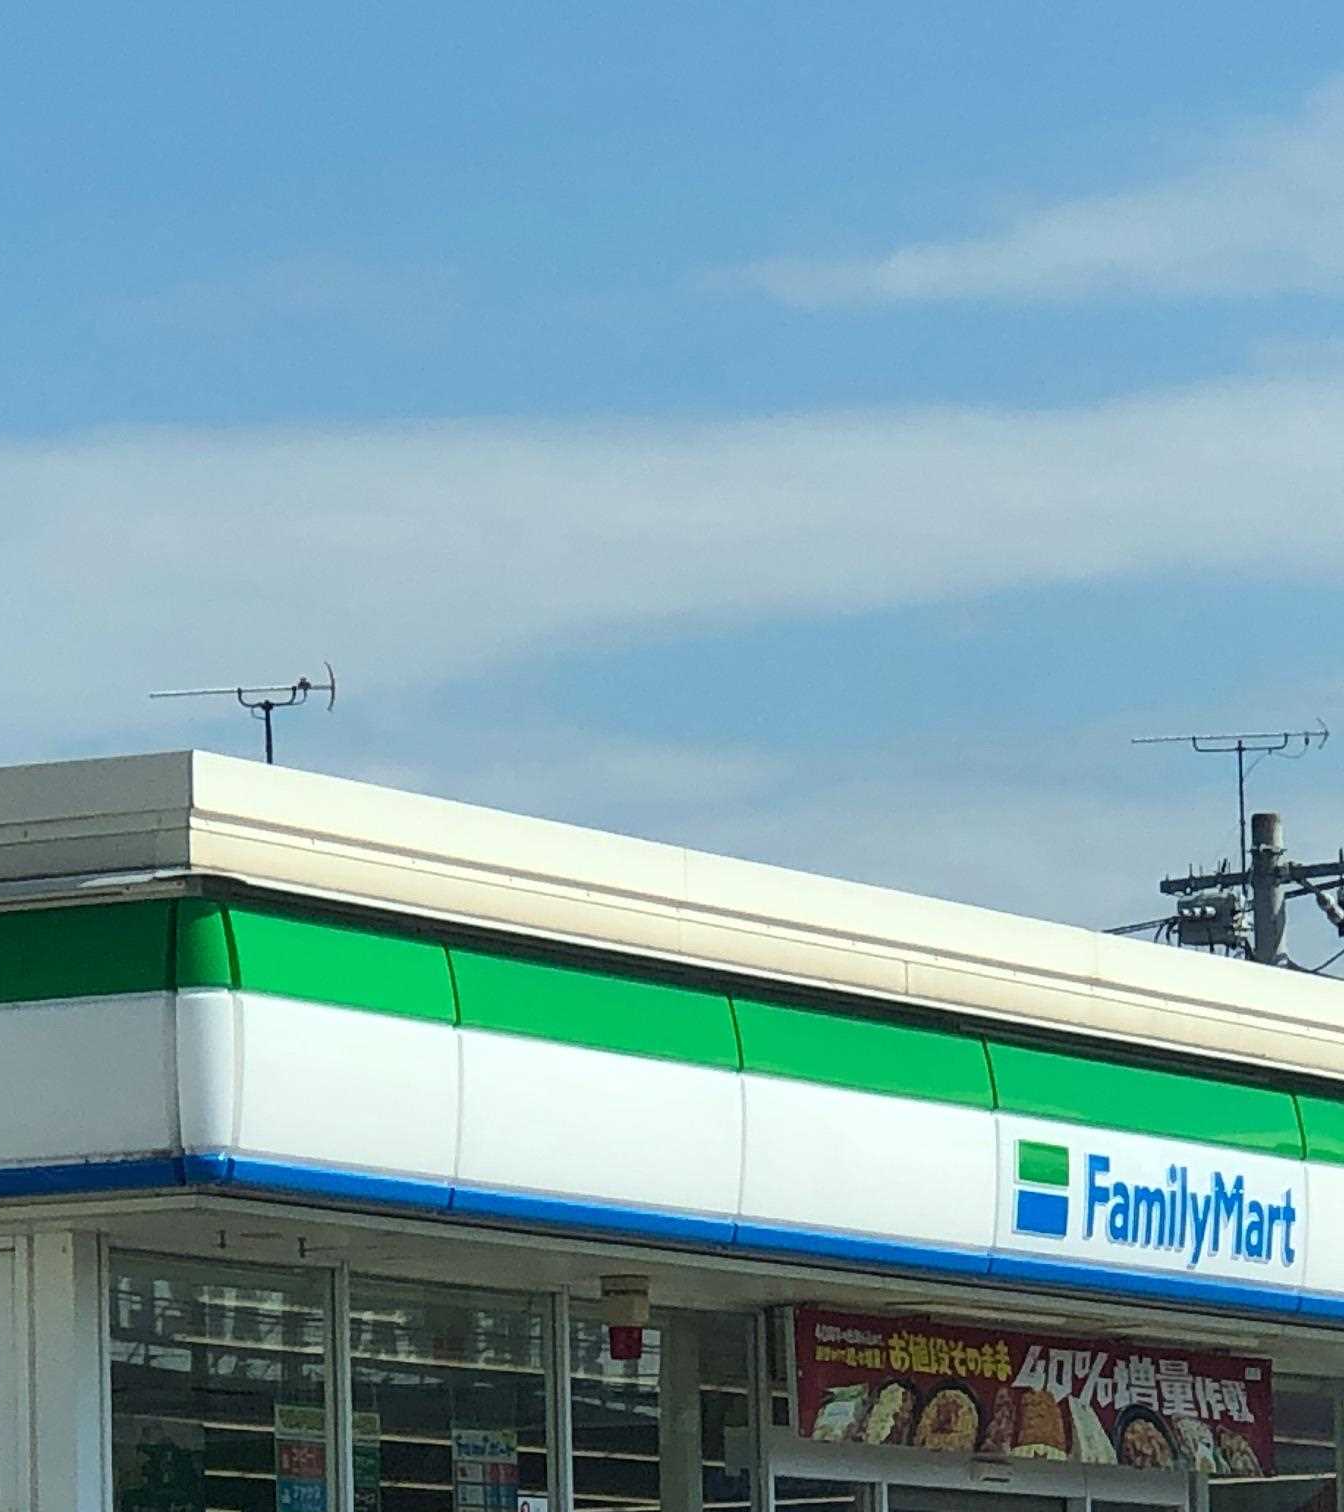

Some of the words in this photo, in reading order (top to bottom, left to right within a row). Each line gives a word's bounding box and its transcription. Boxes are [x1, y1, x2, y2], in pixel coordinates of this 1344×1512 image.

[1083, 1152, 1297, 1270] FamilyMart
[887, 1330, 1012, 1382] お値段そのまま
[1009, 1345, 1254, 1424] 40%増量作戦
